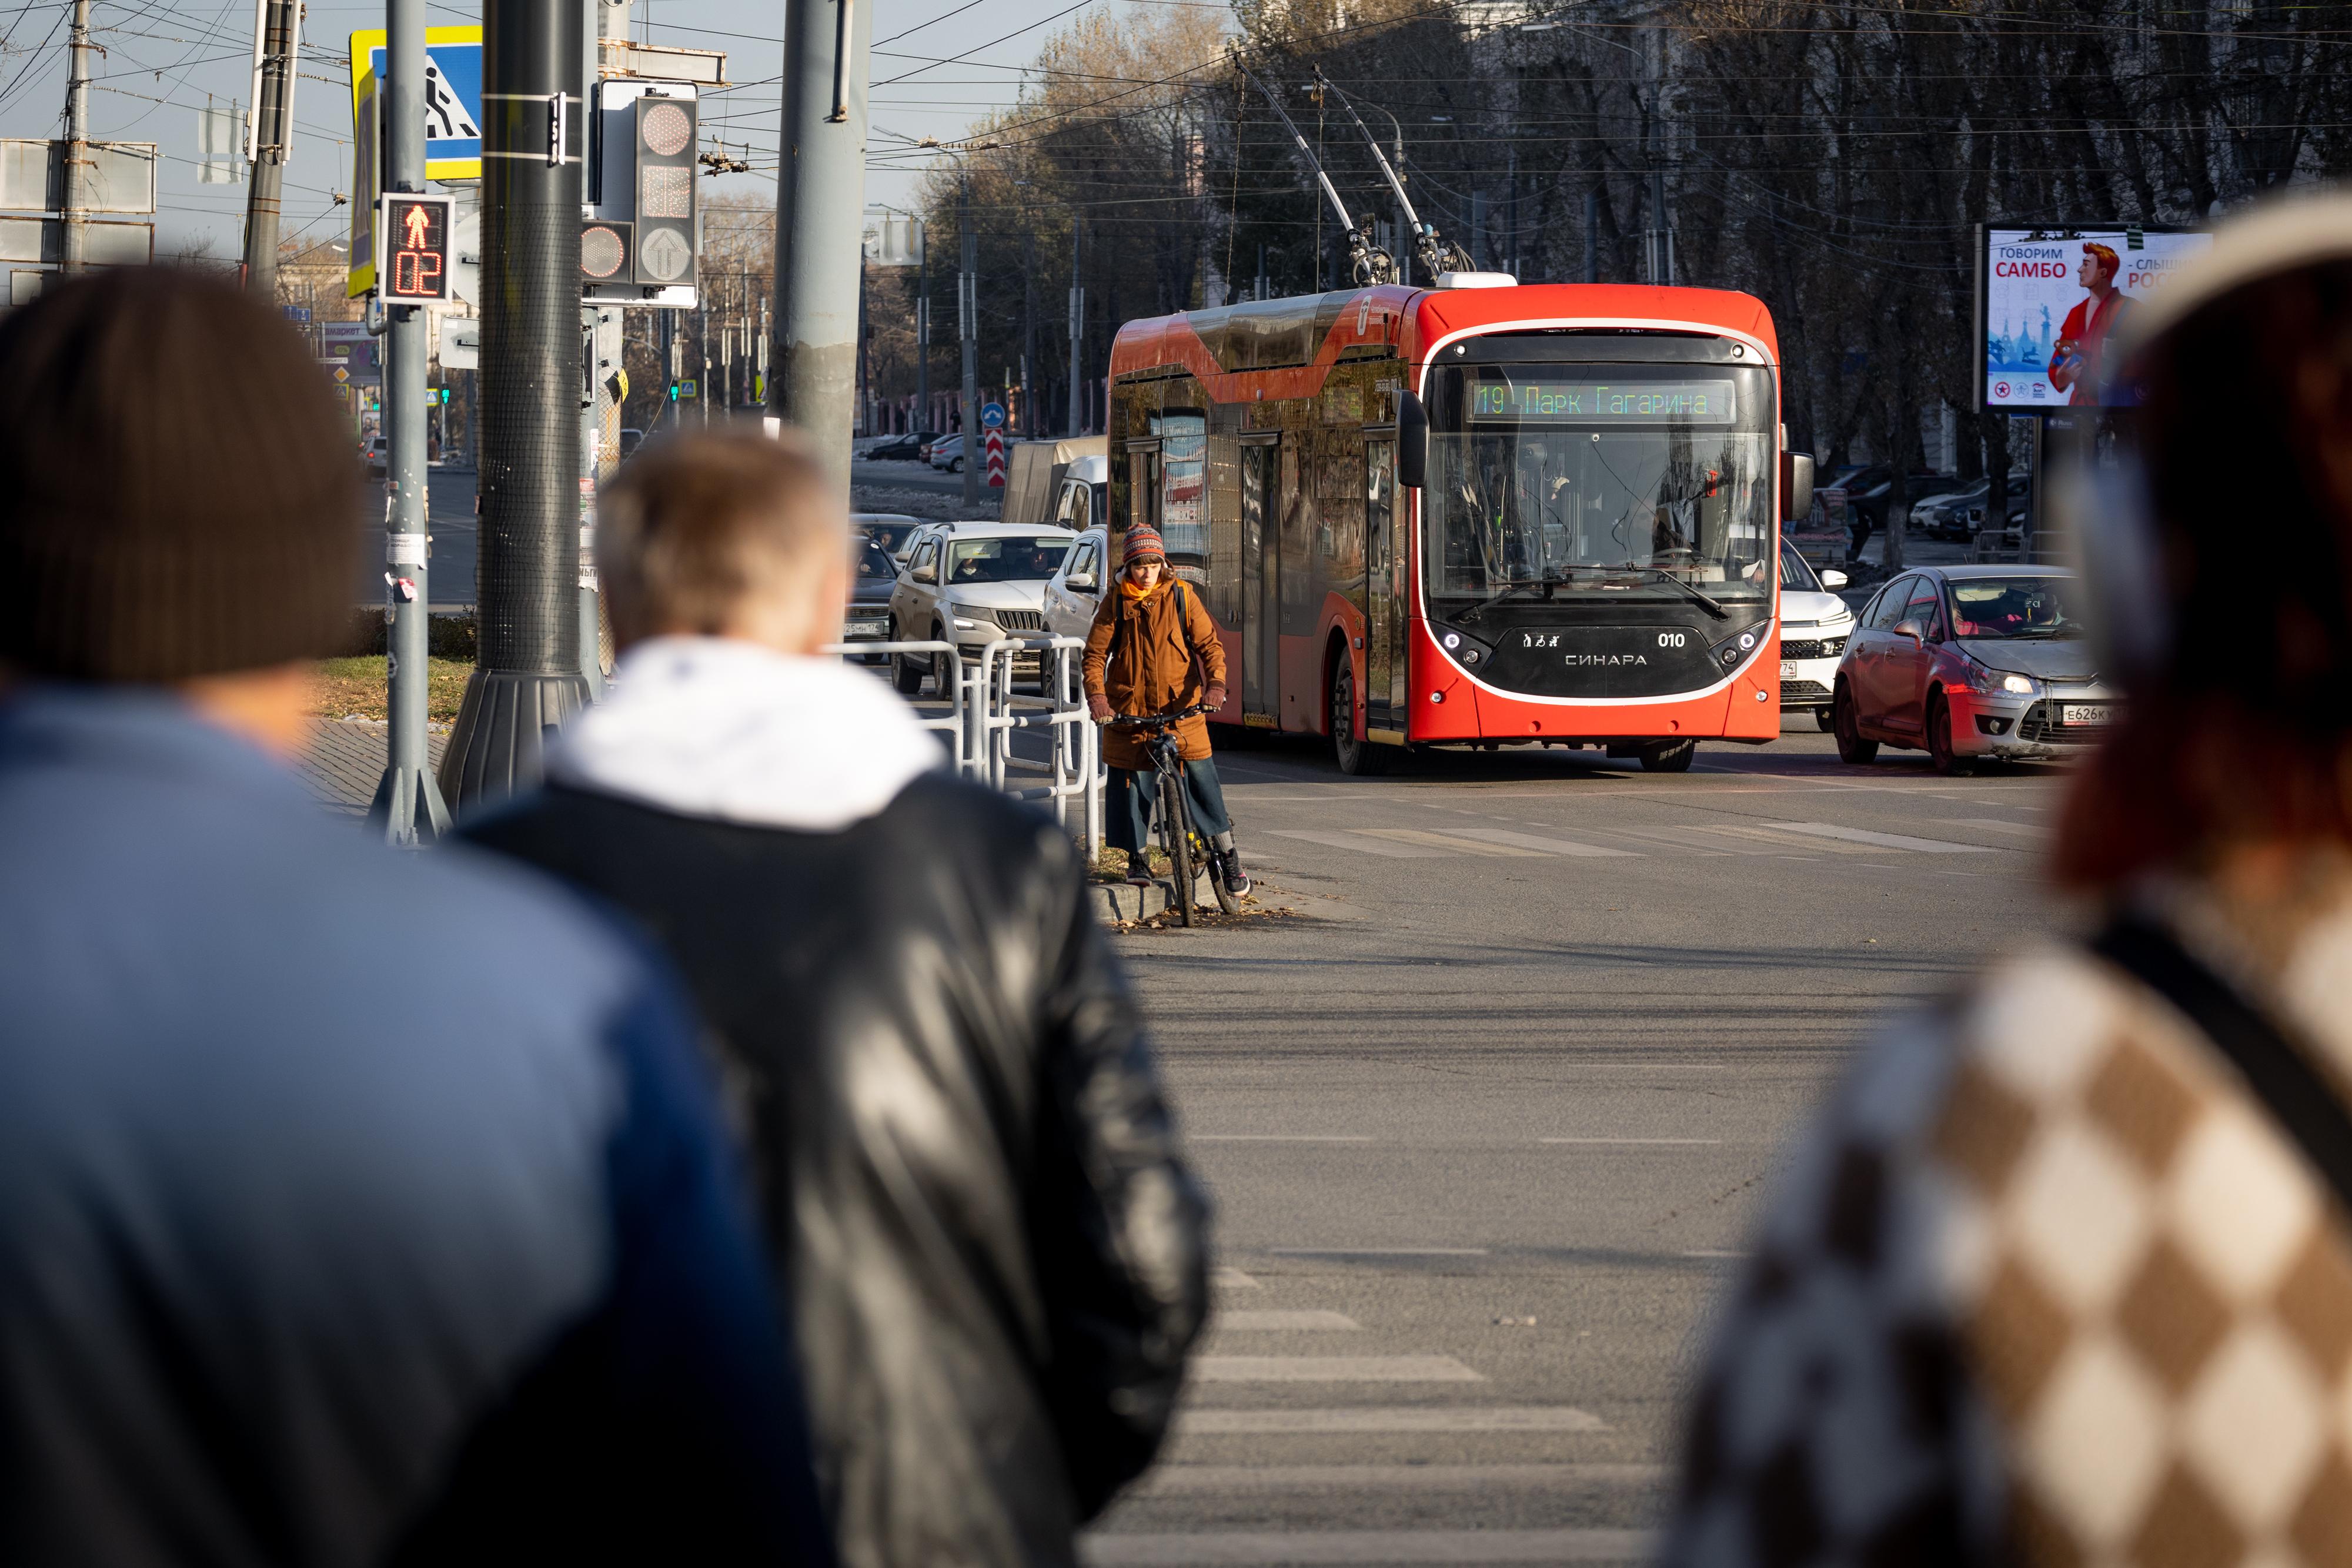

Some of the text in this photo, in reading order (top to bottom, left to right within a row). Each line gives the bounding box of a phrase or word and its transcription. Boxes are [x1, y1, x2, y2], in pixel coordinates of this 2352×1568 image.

[2000, 248, 2063, 259] ГОВОРИМ
[396, 251, 442, 295] 02
[1996, 261, 2067, 279] САМБО
[1479, 386, 1708, 414] 19 Парк Гагарина
[1658, 633, 1685, 647] 010
[1565, 655, 1647, 666] СИНАРА
[1780, 663, 1793, 671] 74
